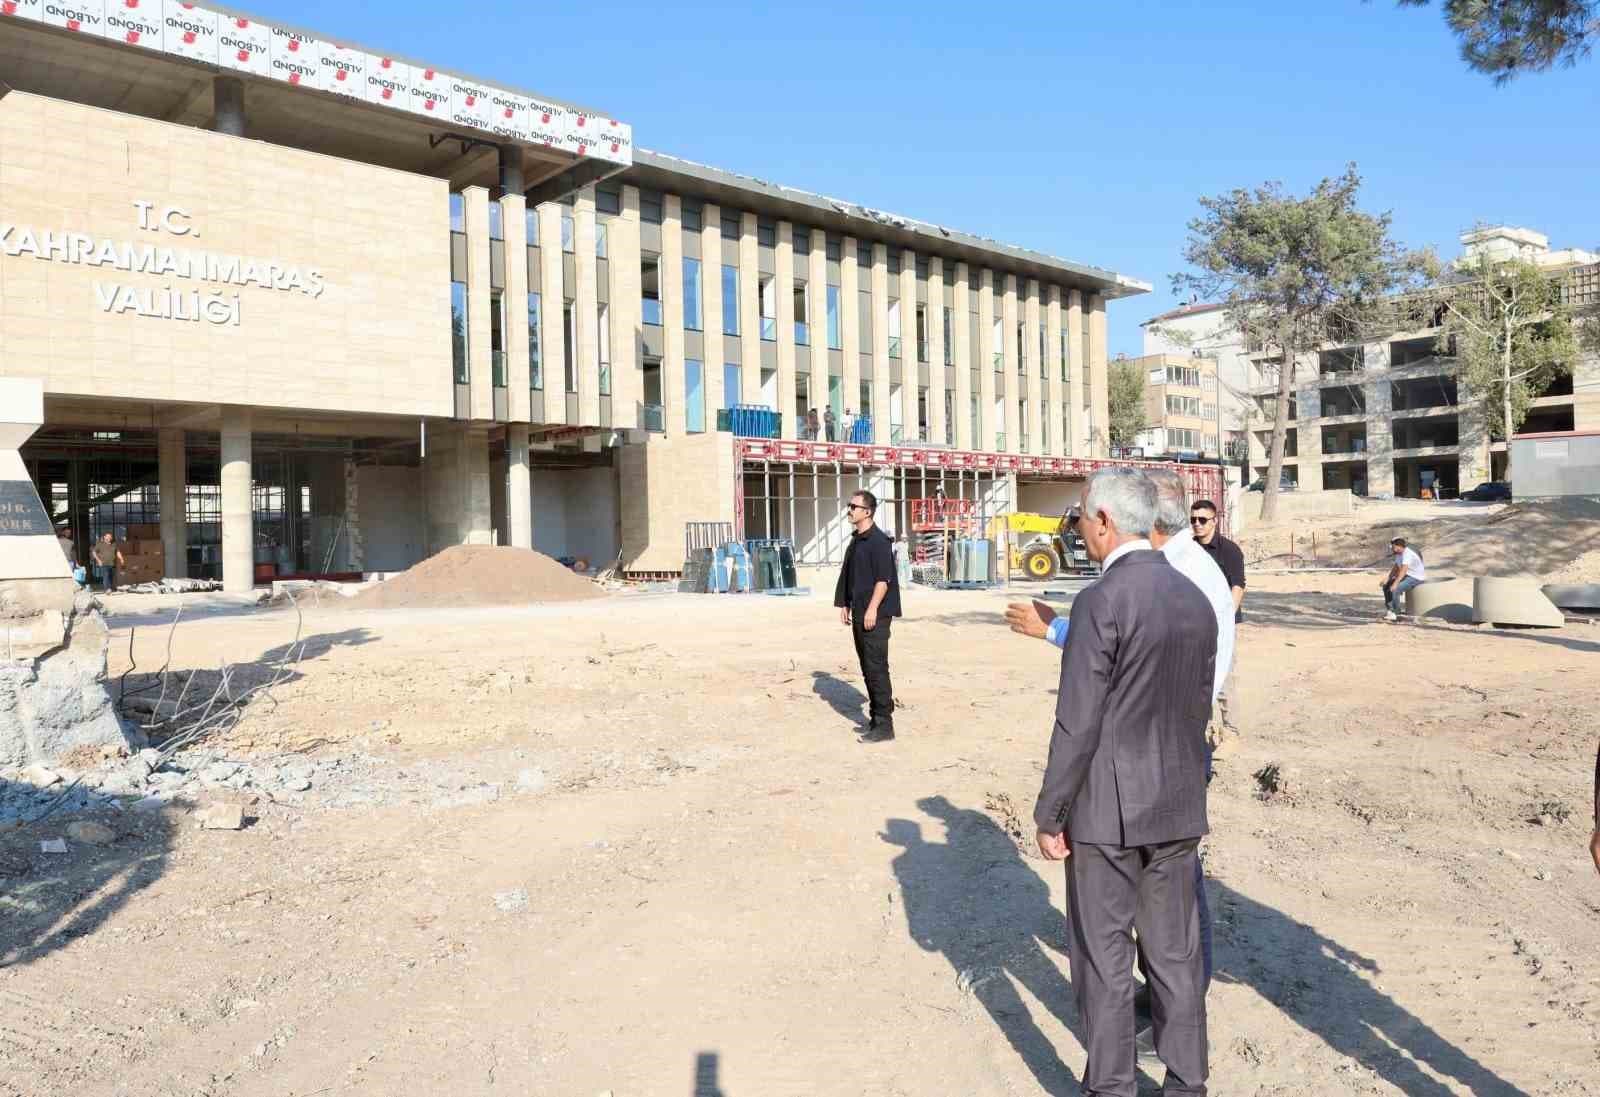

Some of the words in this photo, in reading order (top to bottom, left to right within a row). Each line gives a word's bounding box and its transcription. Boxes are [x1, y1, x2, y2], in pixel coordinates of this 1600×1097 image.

[46, 5, 100, 24] ALBOND
[107, 16, 159, 35] ALBOND
[166, 18, 214, 36] ALBOND
[220, 36, 266, 54] ALBOND
[273, 60, 316, 77] ALBOND
[321, 57, 363, 73] ALBOND
[368, 76, 407, 92] ALBOND
[453, 84, 488, 99] ALBOND
[411, 88, 448, 103] ALBOND
[493, 97, 526, 111] ALBOND
[531, 102, 563, 116] ALBOND
[454, 115, 489, 128] ALBOND
[531, 131, 563, 144] ALBOND
[567, 134, 597, 147] ALBOND
[601, 134, 630, 146] ALBOND
[132, 199, 201, 238] T.C.
[94, 280, 241, 326] VALİLİĞİ
